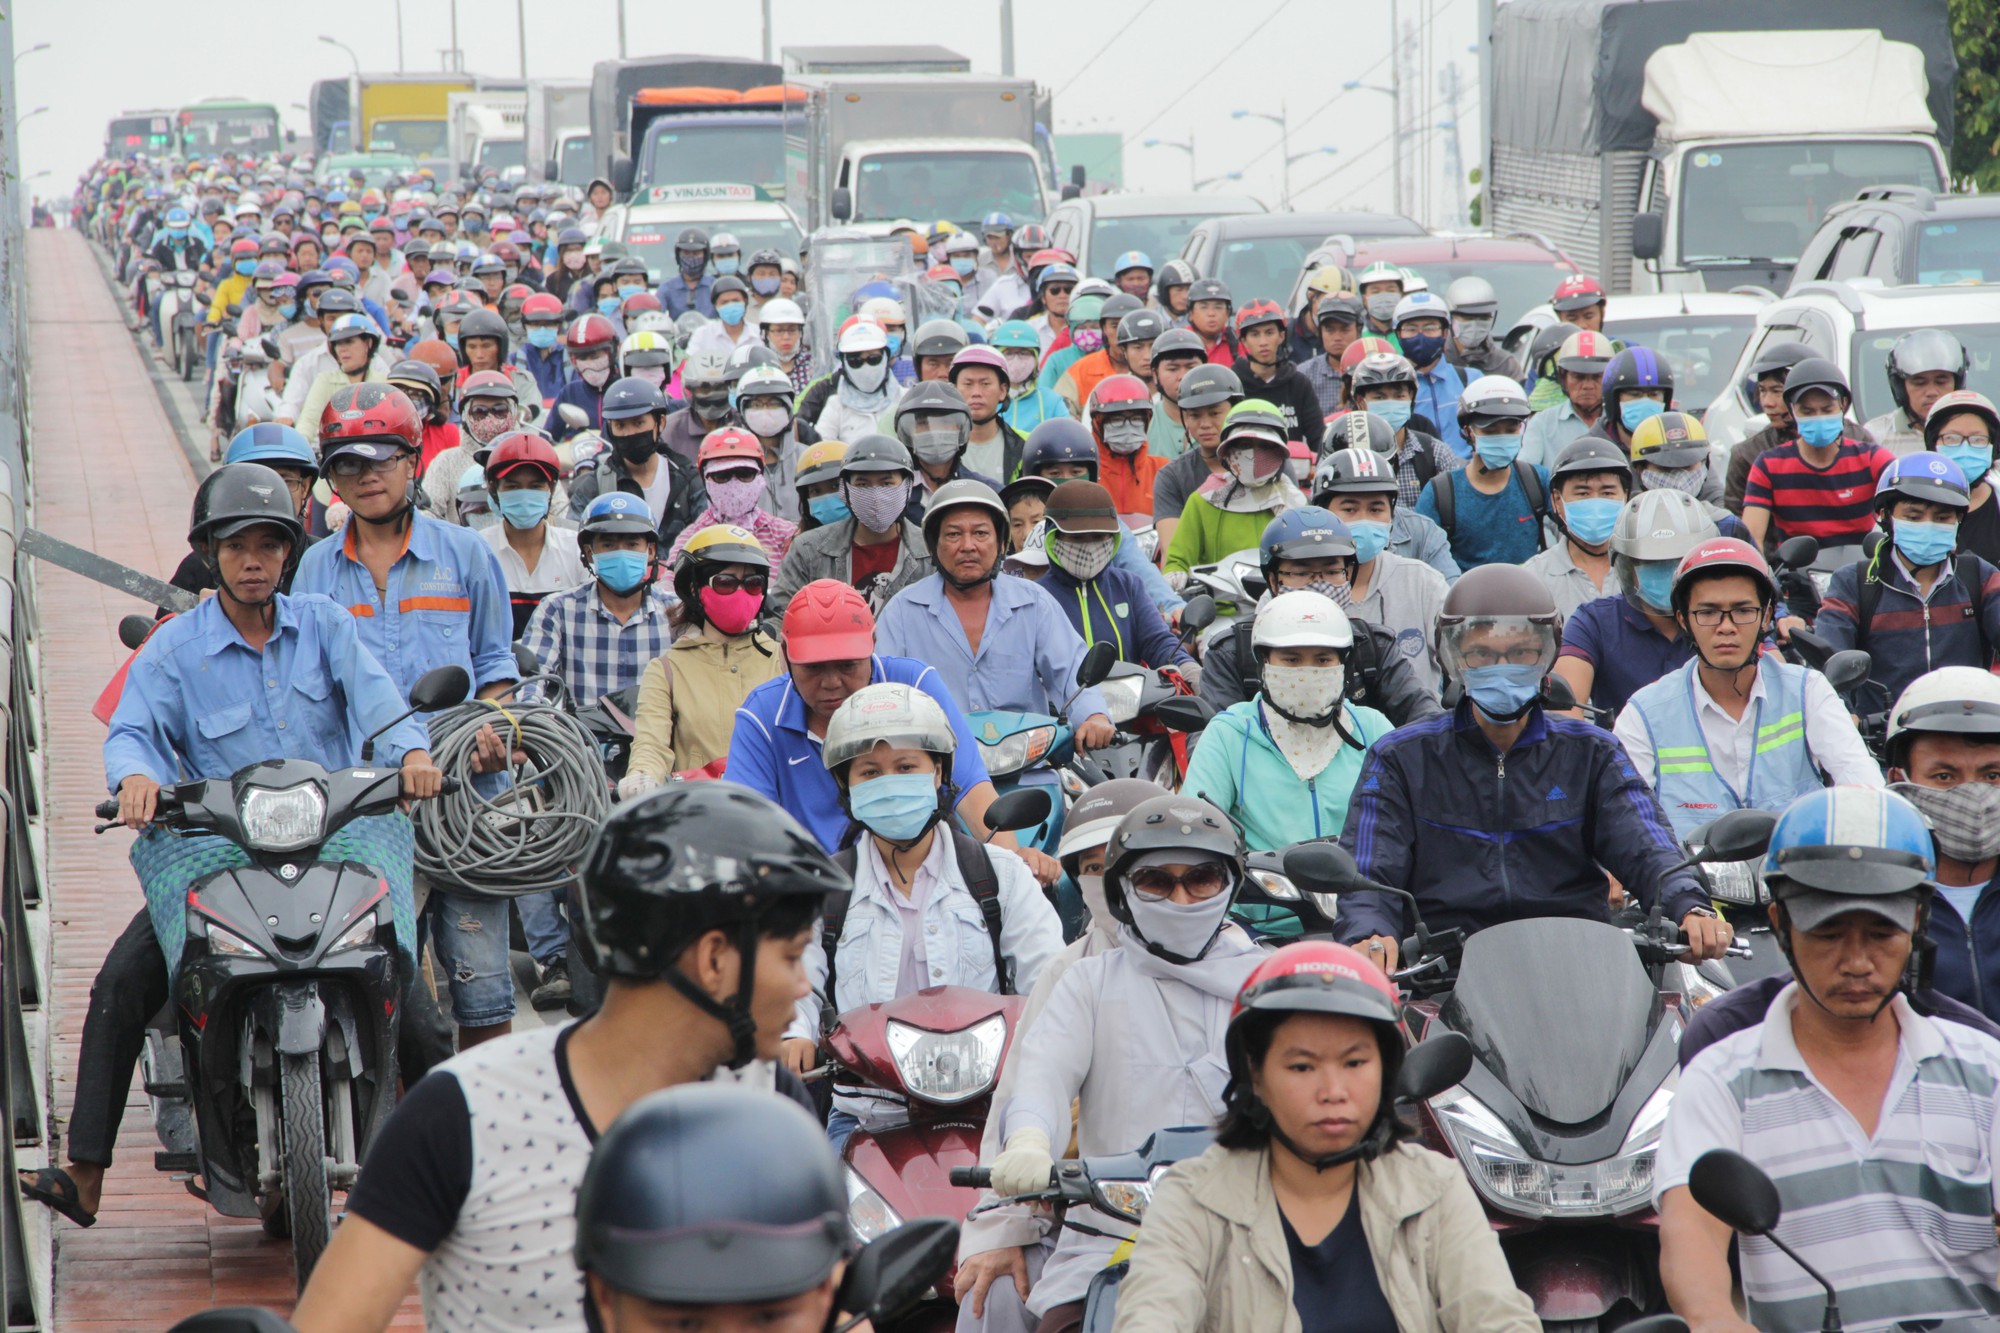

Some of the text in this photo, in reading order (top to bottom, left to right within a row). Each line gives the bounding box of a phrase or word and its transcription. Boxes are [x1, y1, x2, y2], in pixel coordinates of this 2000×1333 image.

[674, 185, 752, 197] VINASUNTAXI
[1301, 528, 1334, 537] SELDAT
[1294, 961, 1361, 981] HONDA
[932, 1121, 977, 1131] HONDA
